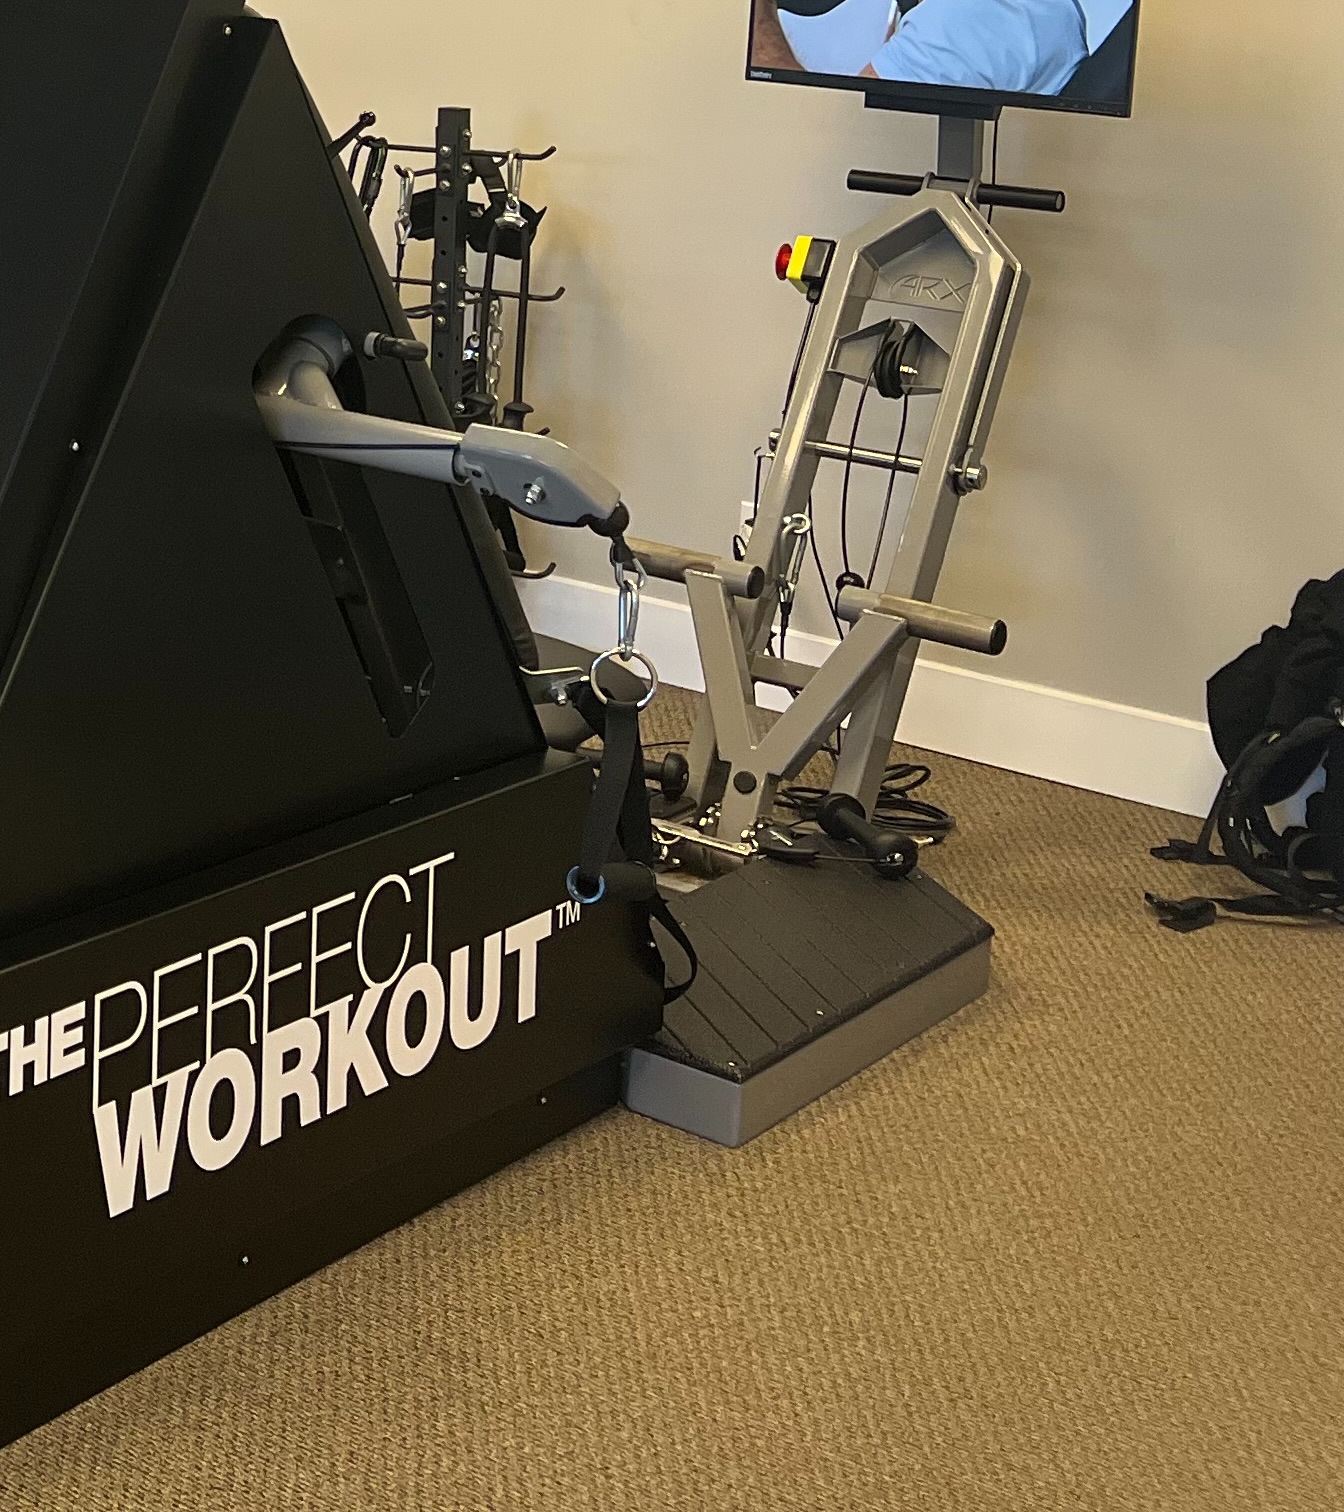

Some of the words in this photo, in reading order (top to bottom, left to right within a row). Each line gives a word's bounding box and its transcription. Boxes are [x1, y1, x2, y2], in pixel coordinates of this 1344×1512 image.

[888, 274, 973, 305] ARX
[92, 851, 455, 1116] PERFECT
[92, 909, 553, 1219] WORKOUT
